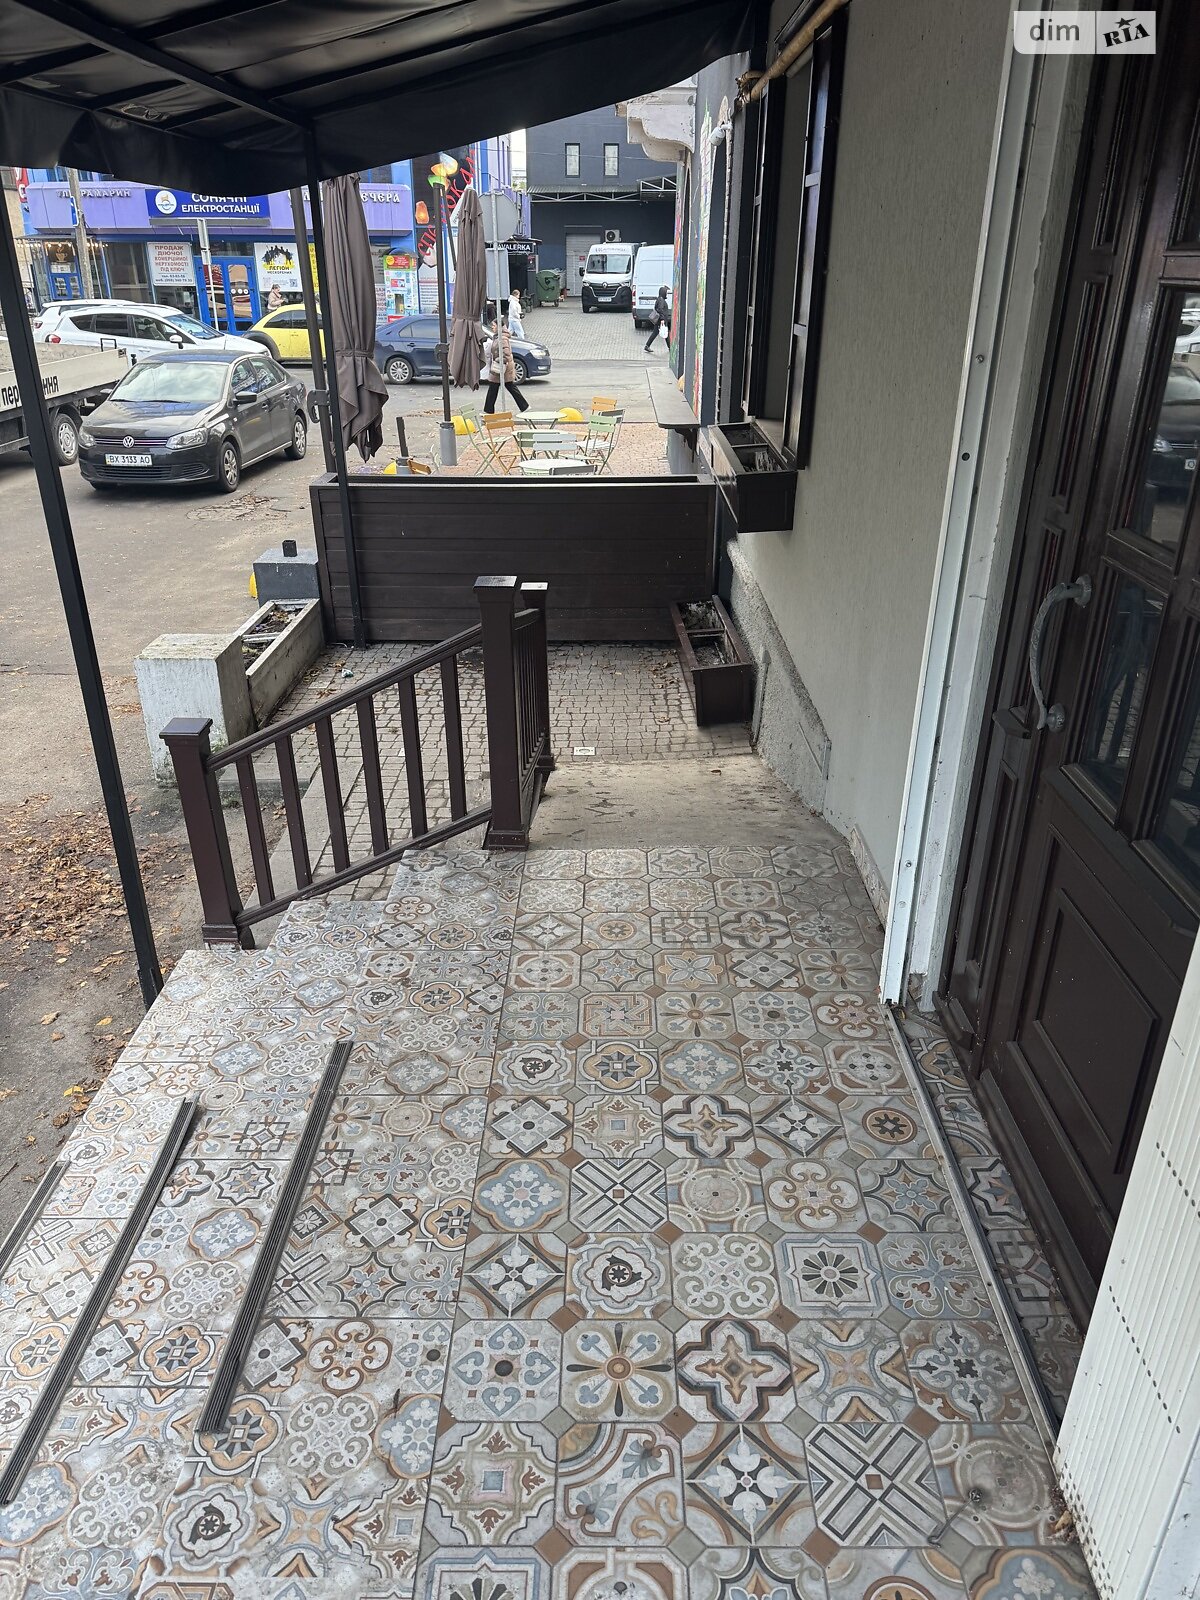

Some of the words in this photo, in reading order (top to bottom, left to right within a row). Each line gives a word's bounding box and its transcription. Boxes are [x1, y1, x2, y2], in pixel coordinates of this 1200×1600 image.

[56, 188, 131, 198] УЛРАМАРИН
[181, 204, 260, 214] ЕЛЕКТРОСТАНЦІЇ
[497, 243, 531, 251] AVALERKA
[121, 455, 137, 464] 3133
